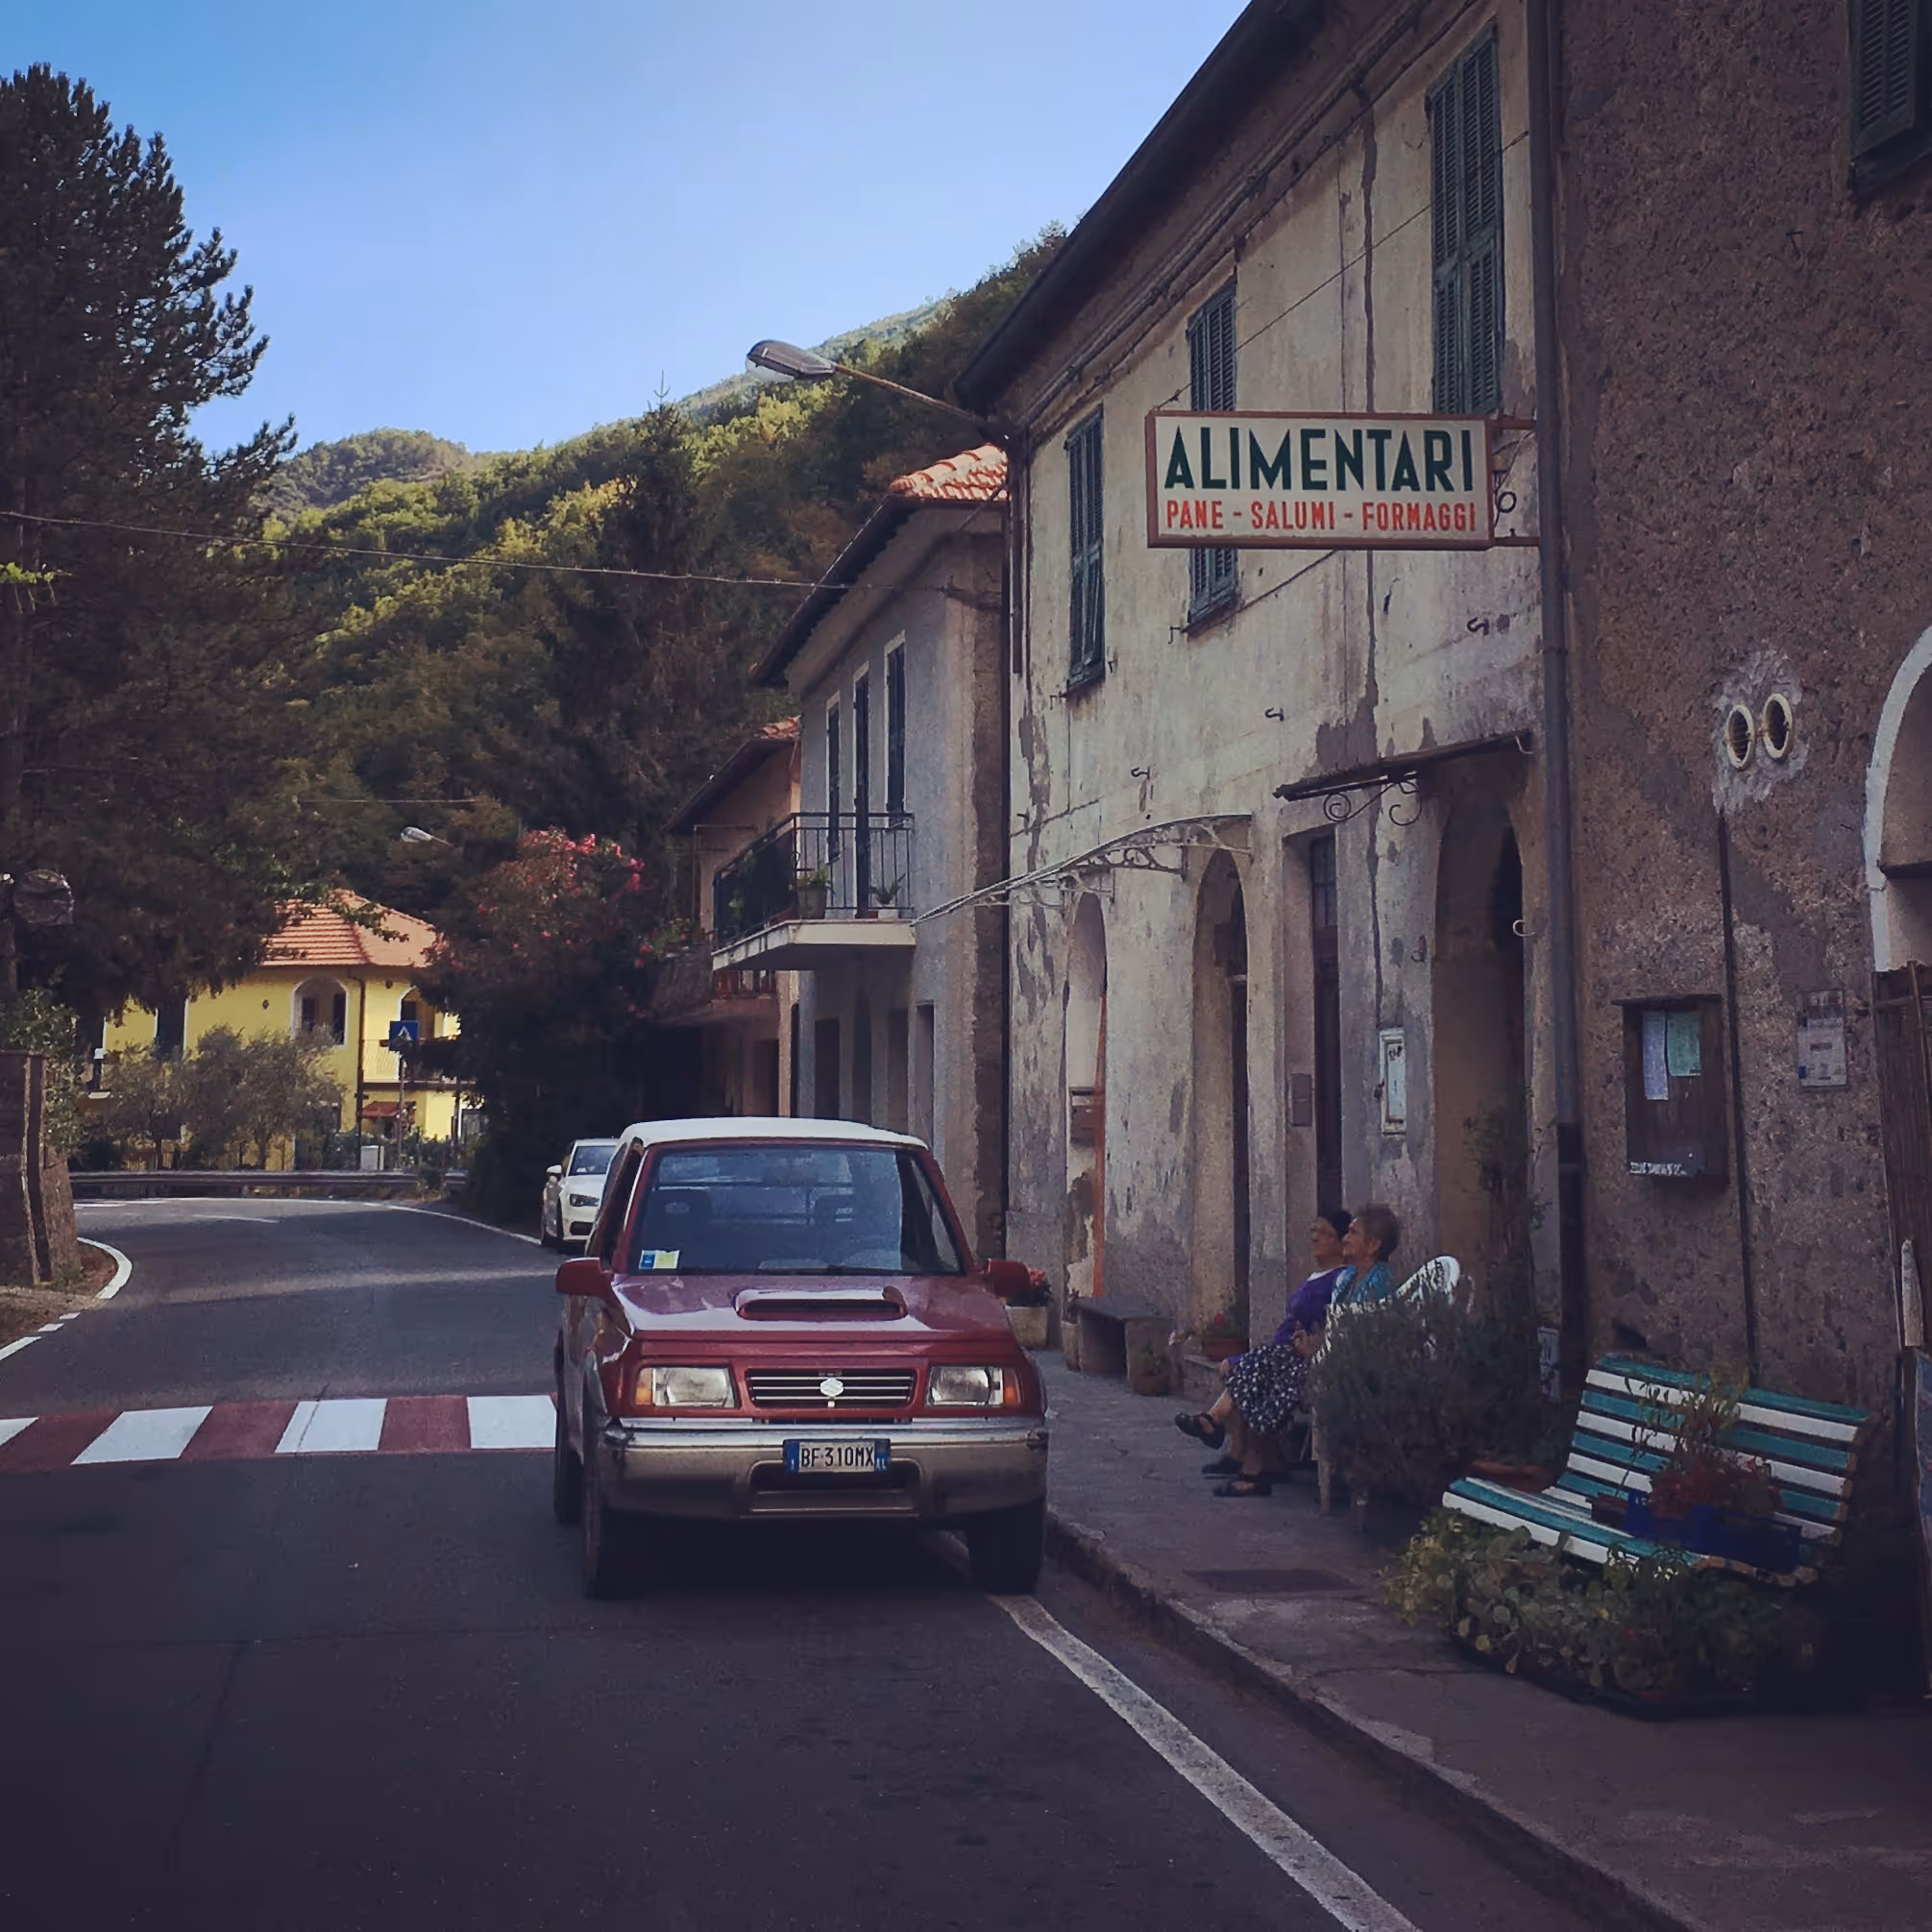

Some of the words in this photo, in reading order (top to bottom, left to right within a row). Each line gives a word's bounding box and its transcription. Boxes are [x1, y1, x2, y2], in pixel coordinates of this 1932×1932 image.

[1163, 425, 1474, 492] ALIMENTARI
[1166, 500, 1224, 529] PANE
[1251, 501, 1335, 530] SALUMI
[1362, 501, 1476, 531] FORMAGGI
